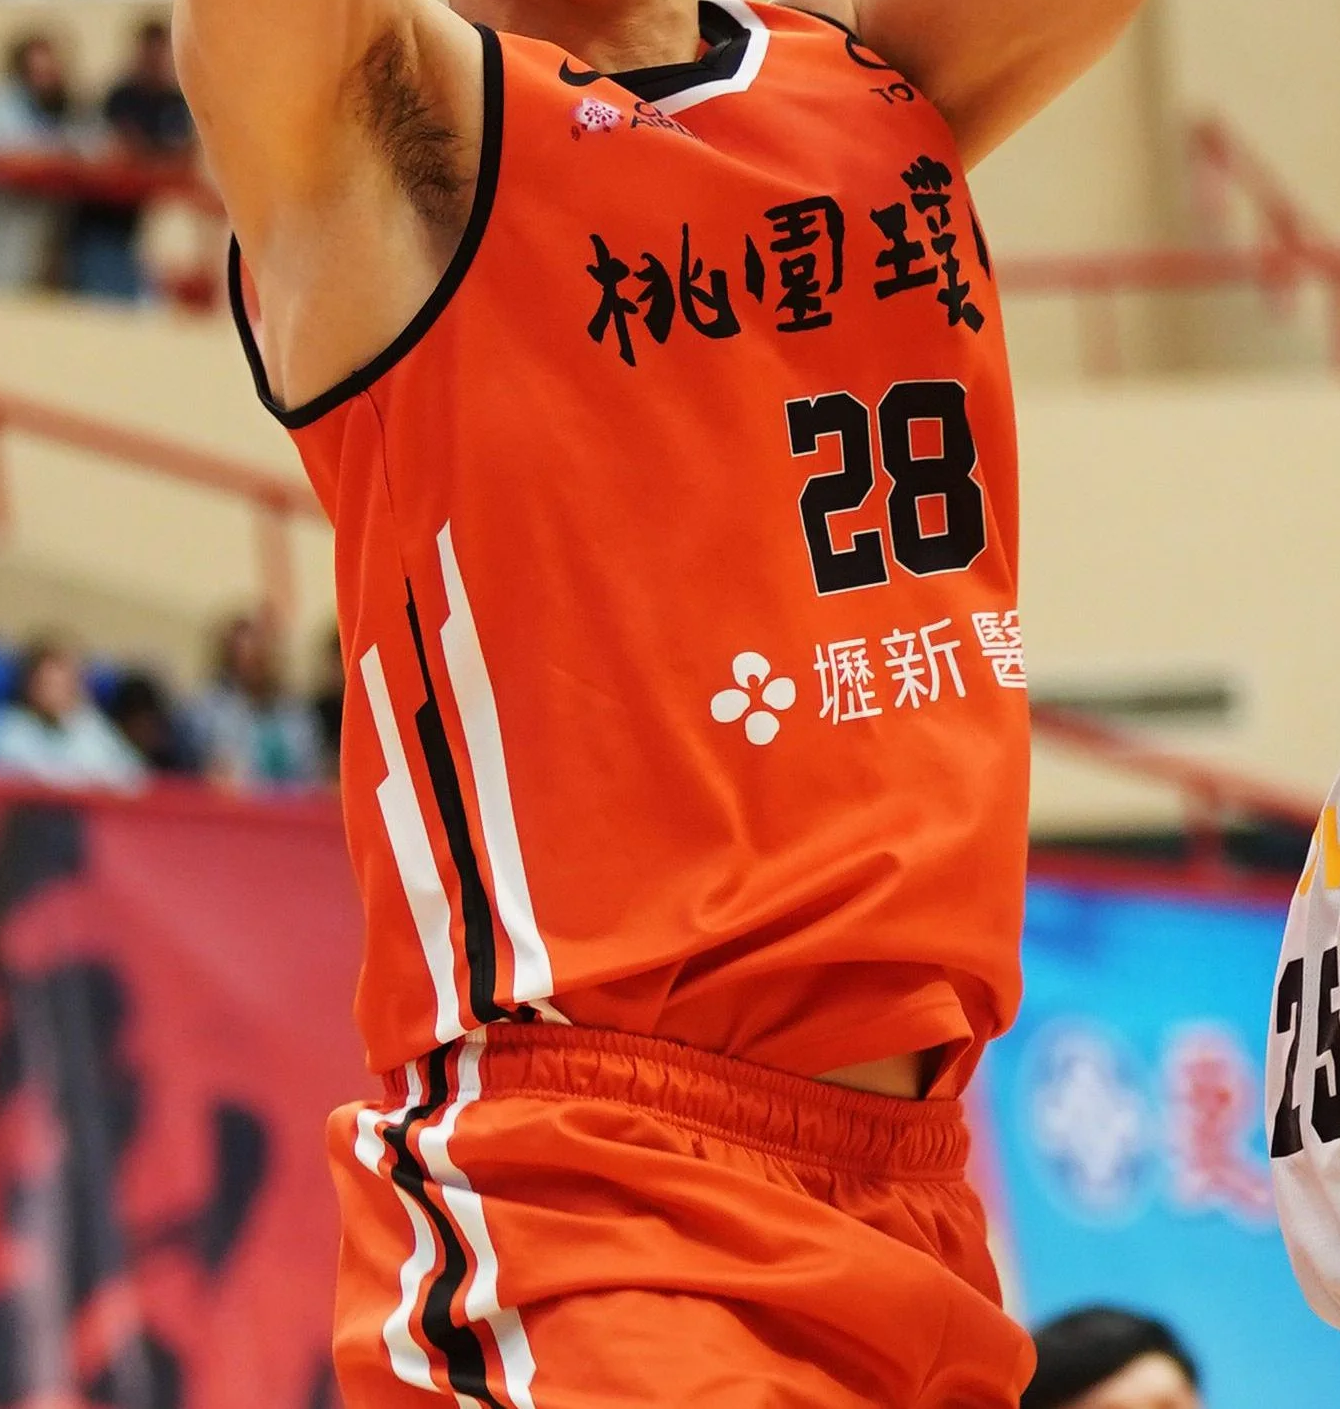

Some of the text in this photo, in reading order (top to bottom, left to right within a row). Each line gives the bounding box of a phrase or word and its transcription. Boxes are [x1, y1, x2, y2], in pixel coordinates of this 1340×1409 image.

[586, 154, 992, 367] 桃園璞
[785, 378, 988, 597] 28
